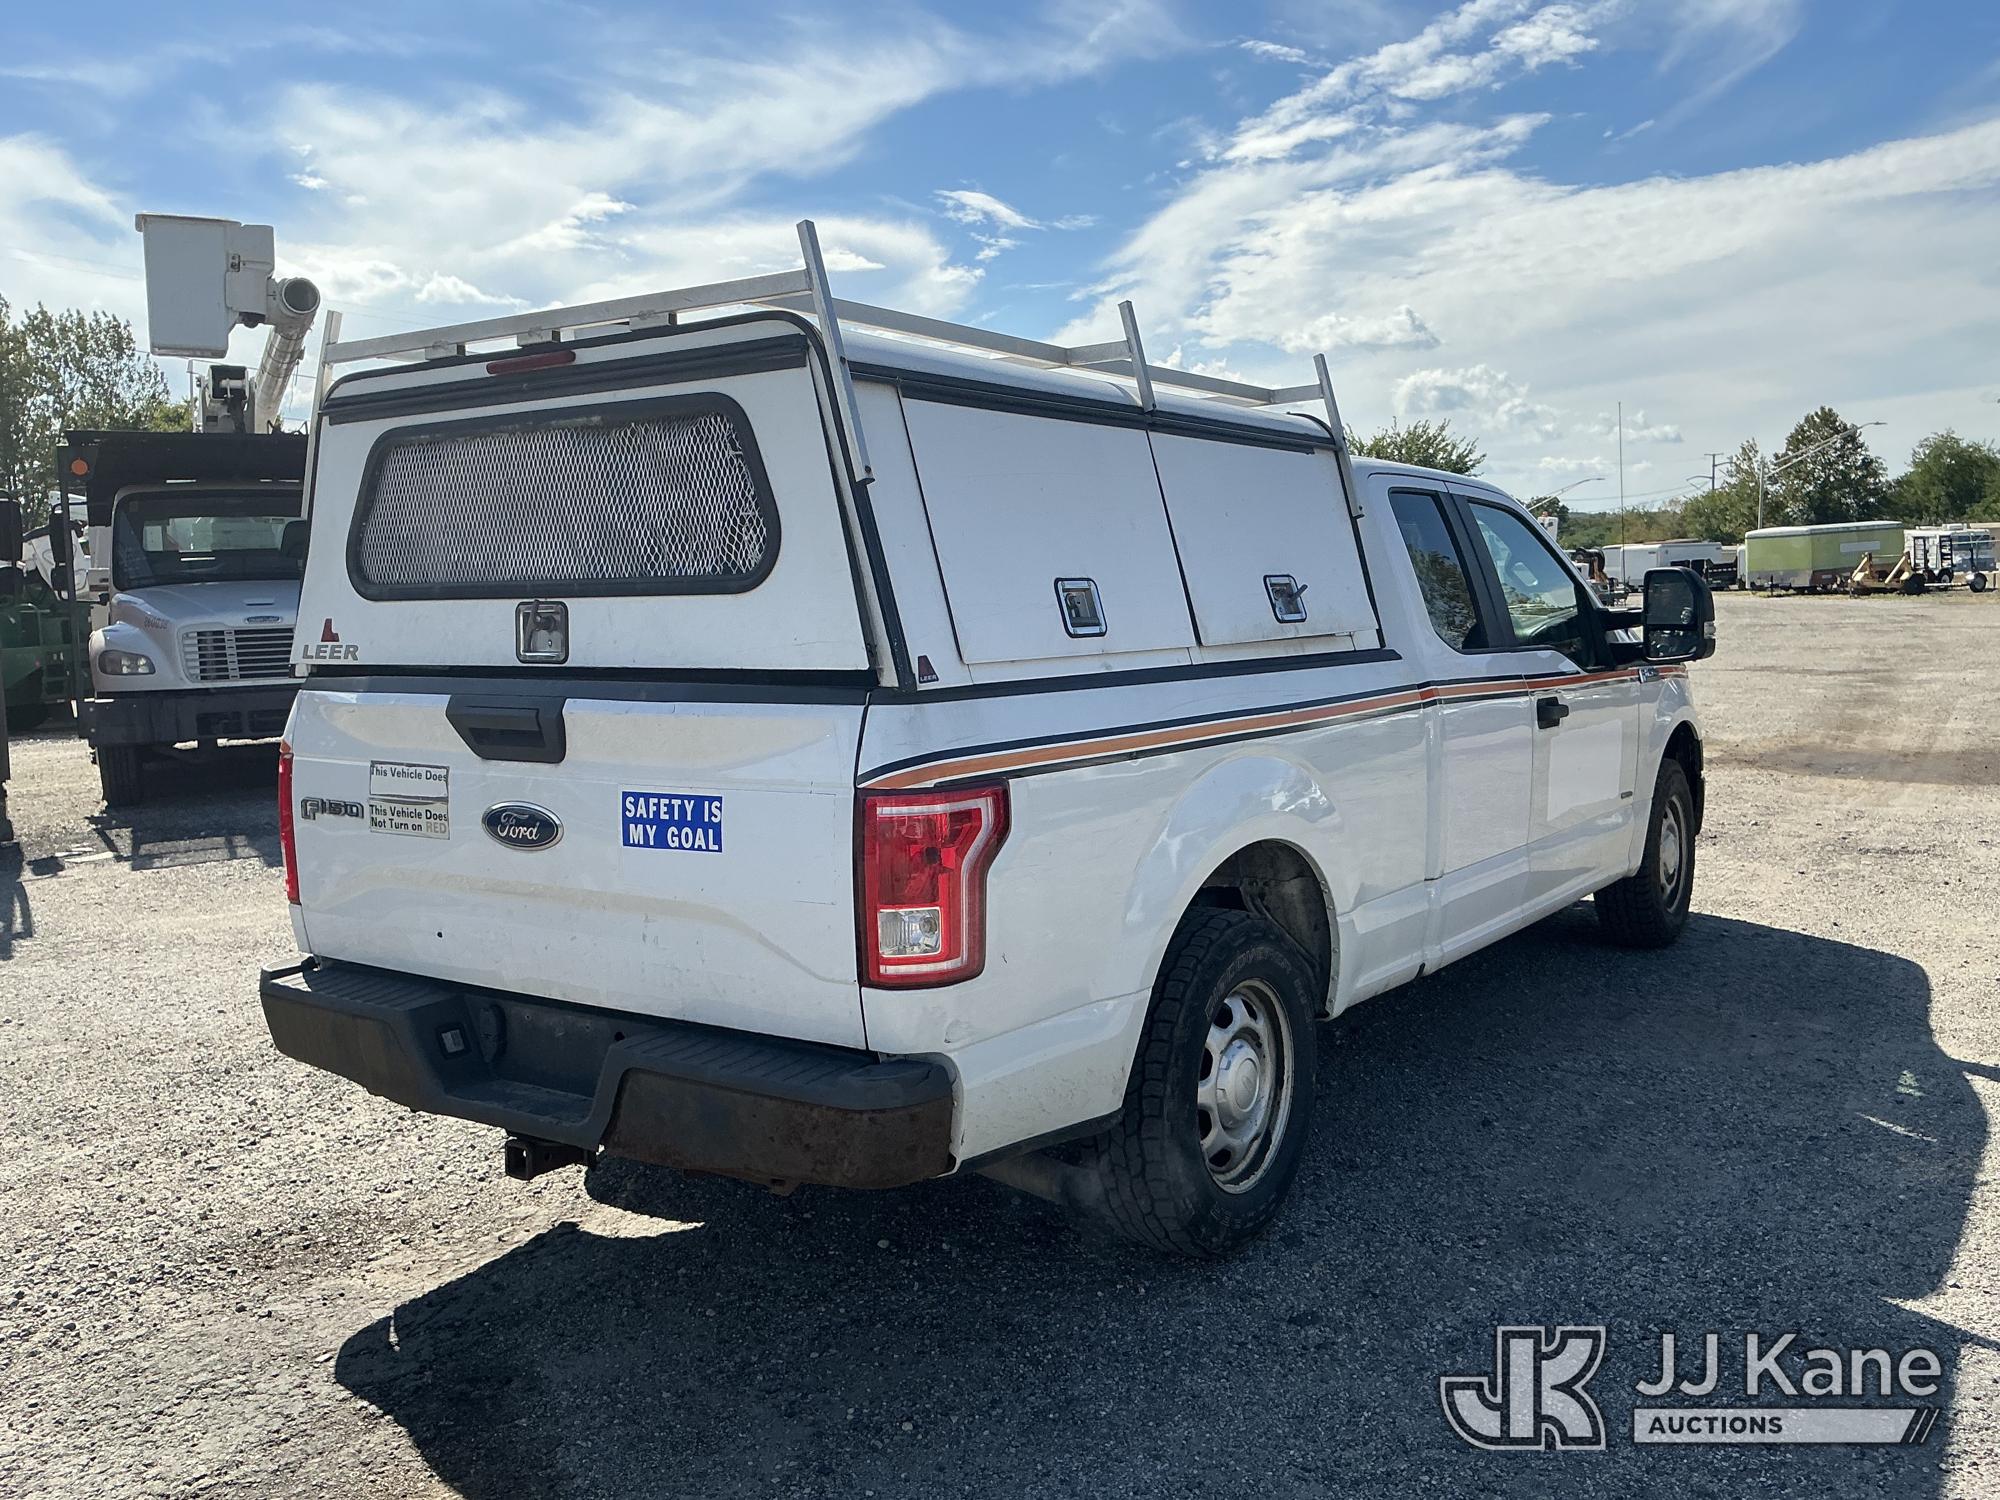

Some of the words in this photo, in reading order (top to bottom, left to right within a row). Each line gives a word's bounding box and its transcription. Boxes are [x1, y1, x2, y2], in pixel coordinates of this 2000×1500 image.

[302, 644, 359, 661] LEER
[371, 765, 388, 777] This
[390, 767, 423, 780] Vehicle
[425, 771, 448, 782] Does
[369, 804, 388, 817] This
[390, 806, 423, 820] Vehicle
[425, 809, 448, 822] Does
[625, 796, 694, 821] SAFETY
[704, 800, 721, 823] IS
[370, 816, 387, 829] Not
[389, 819, 409, 831] Turn
[411, 823, 423, 832] on
[426, 822, 447, 834] RED
[497, 811, 539, 841] Ford
[629, 823, 657, 846] MY
[667, 826, 719, 850] GOAL
